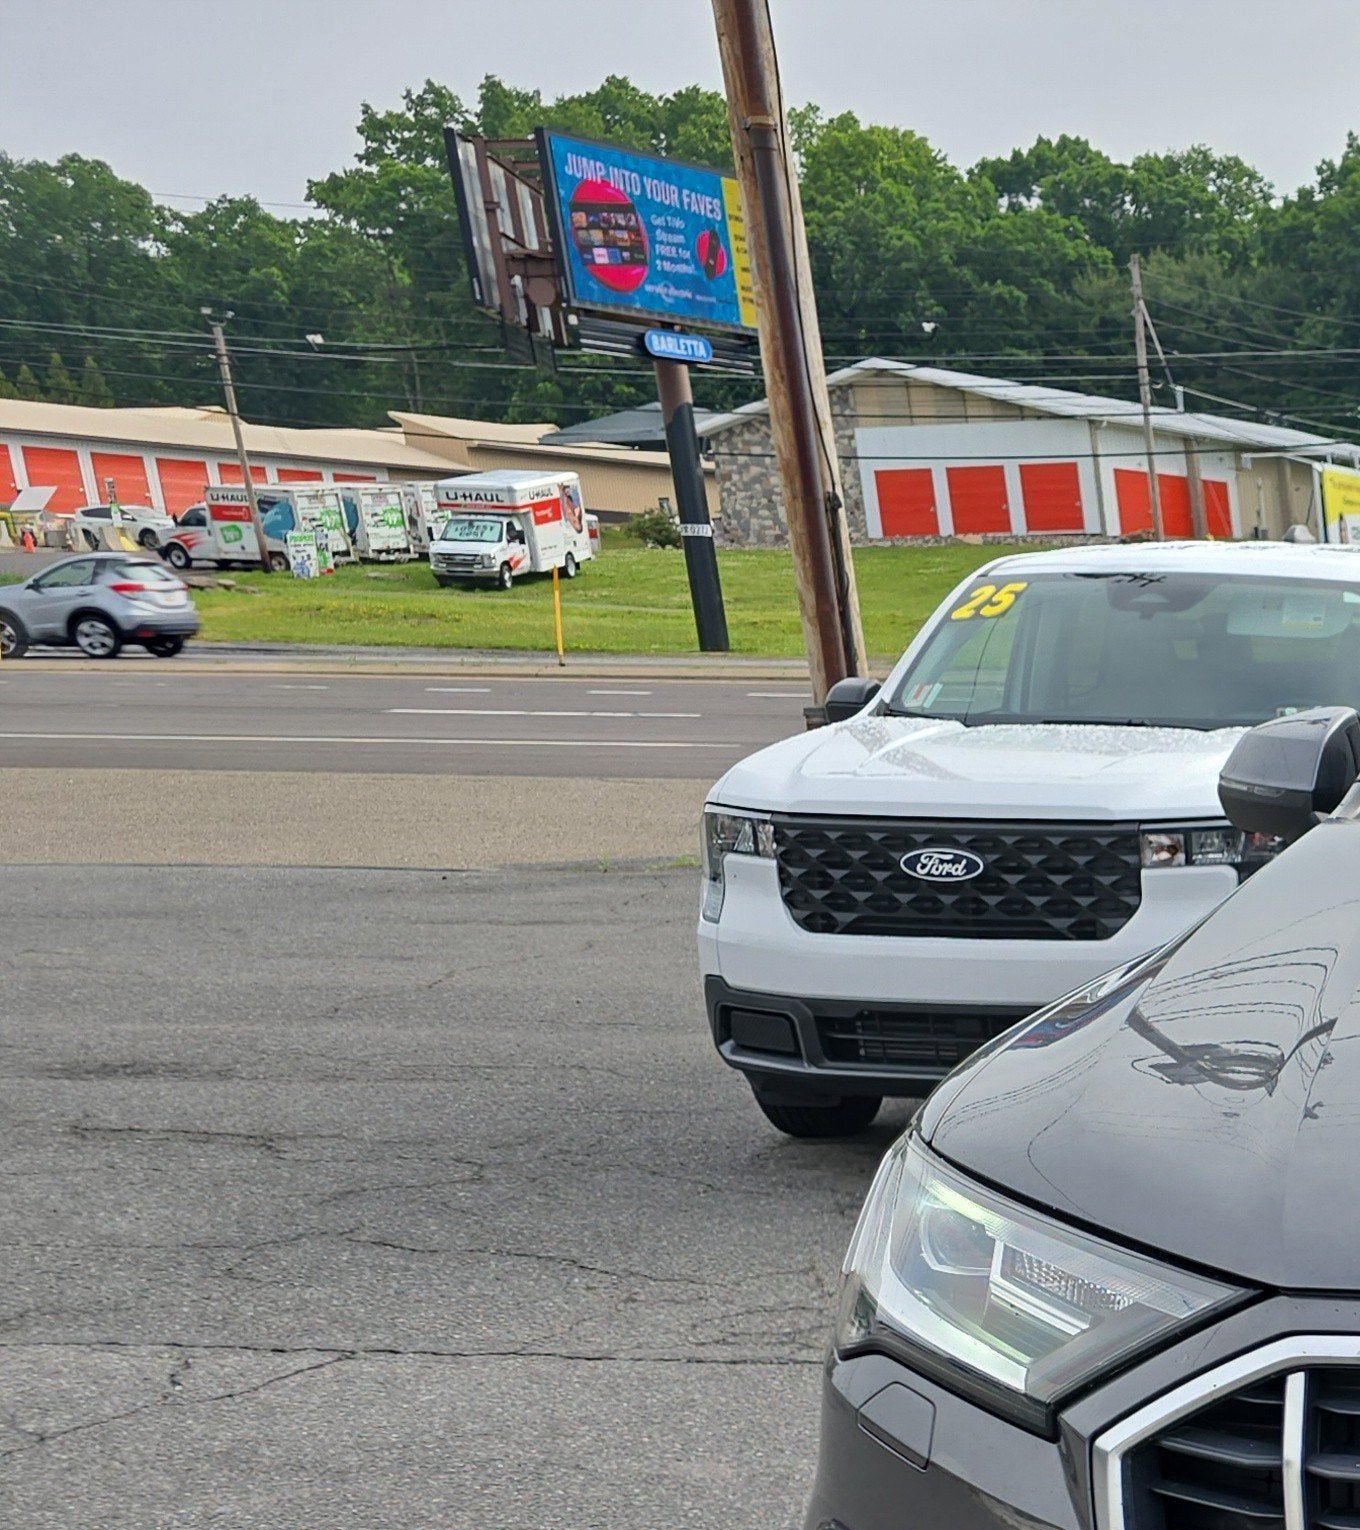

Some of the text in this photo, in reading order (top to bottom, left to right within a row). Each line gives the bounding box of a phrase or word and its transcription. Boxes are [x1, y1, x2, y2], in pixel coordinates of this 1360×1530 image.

[565, 152, 722, 221] JUMP INTO YOUR FAVES
[445, 491, 505, 503] U-HAUL
[950, 581, 1028, 621] 25
[916, 852, 967, 876] Ford
